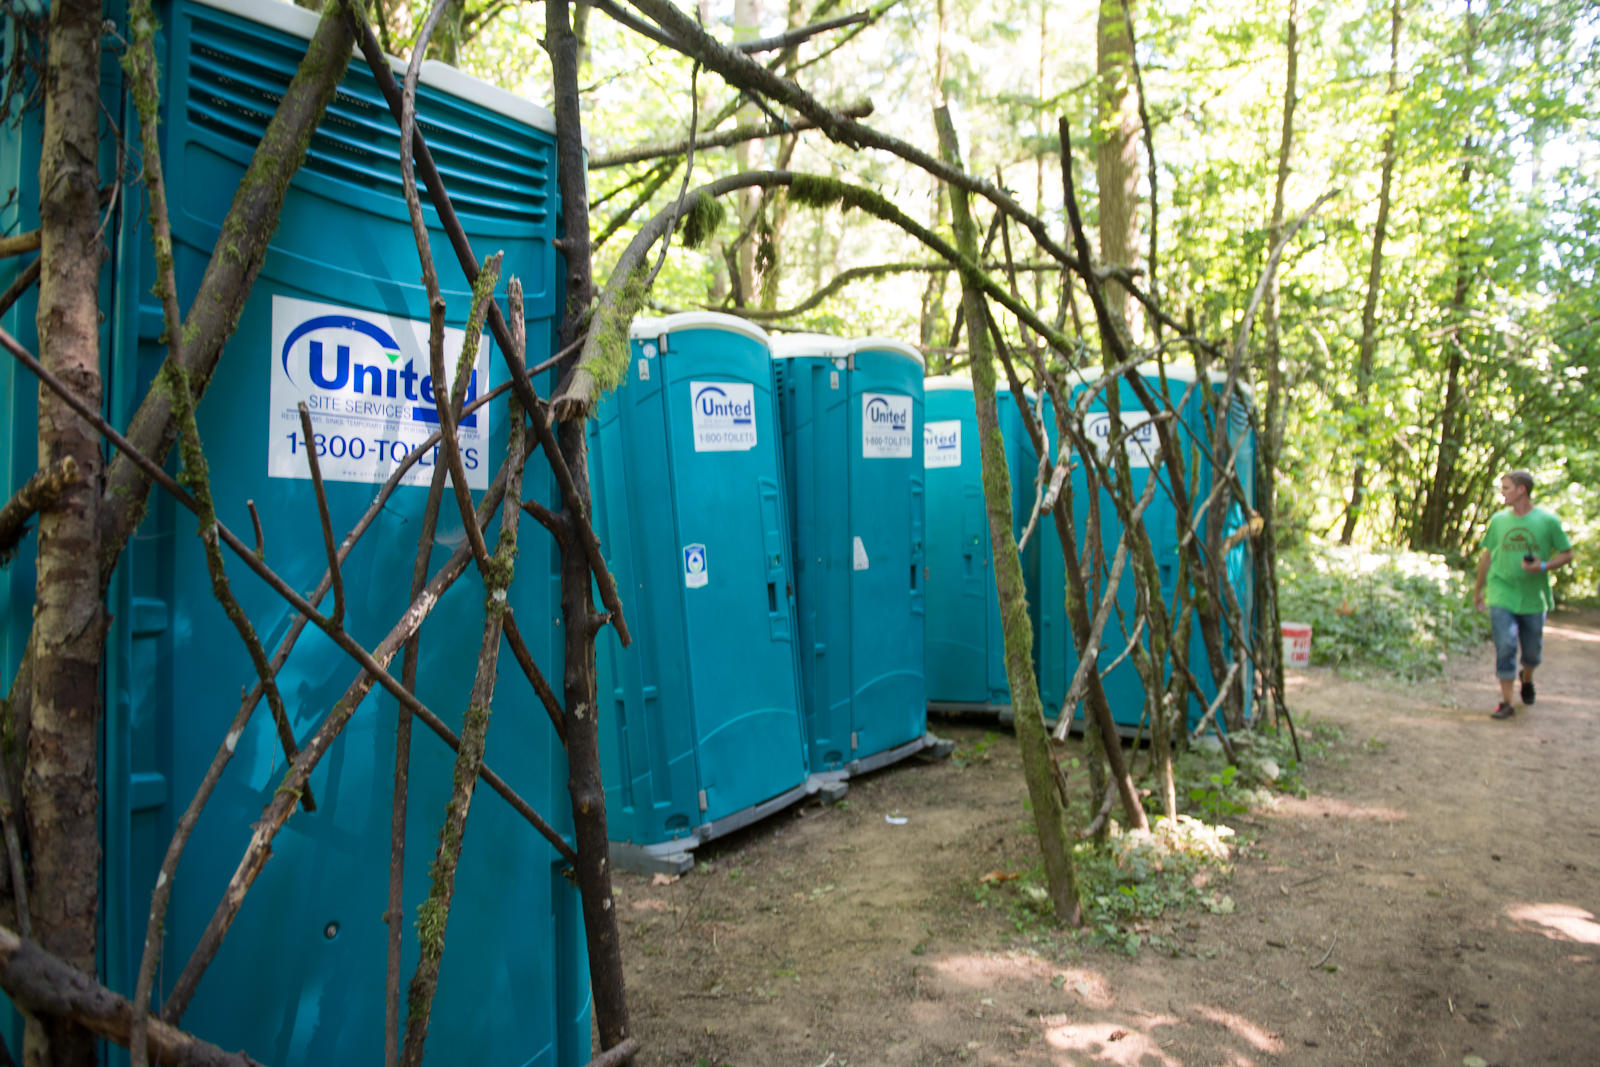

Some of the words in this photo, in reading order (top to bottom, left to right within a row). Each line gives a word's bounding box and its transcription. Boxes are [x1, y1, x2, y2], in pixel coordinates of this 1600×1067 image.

[309, 394, 341, 411] SITE
[345, 399, 412, 419] SERVICES
[702, 398, 752, 417] United
[871, 406, 906, 424] United
[699, 432, 755, 444] 1-800-TOILETS
[865, 436, 911, 447] 1-800-TOILETS
[924, 432, 957, 446] nited
[286, 431, 479, 470] 1-800-TOLS
